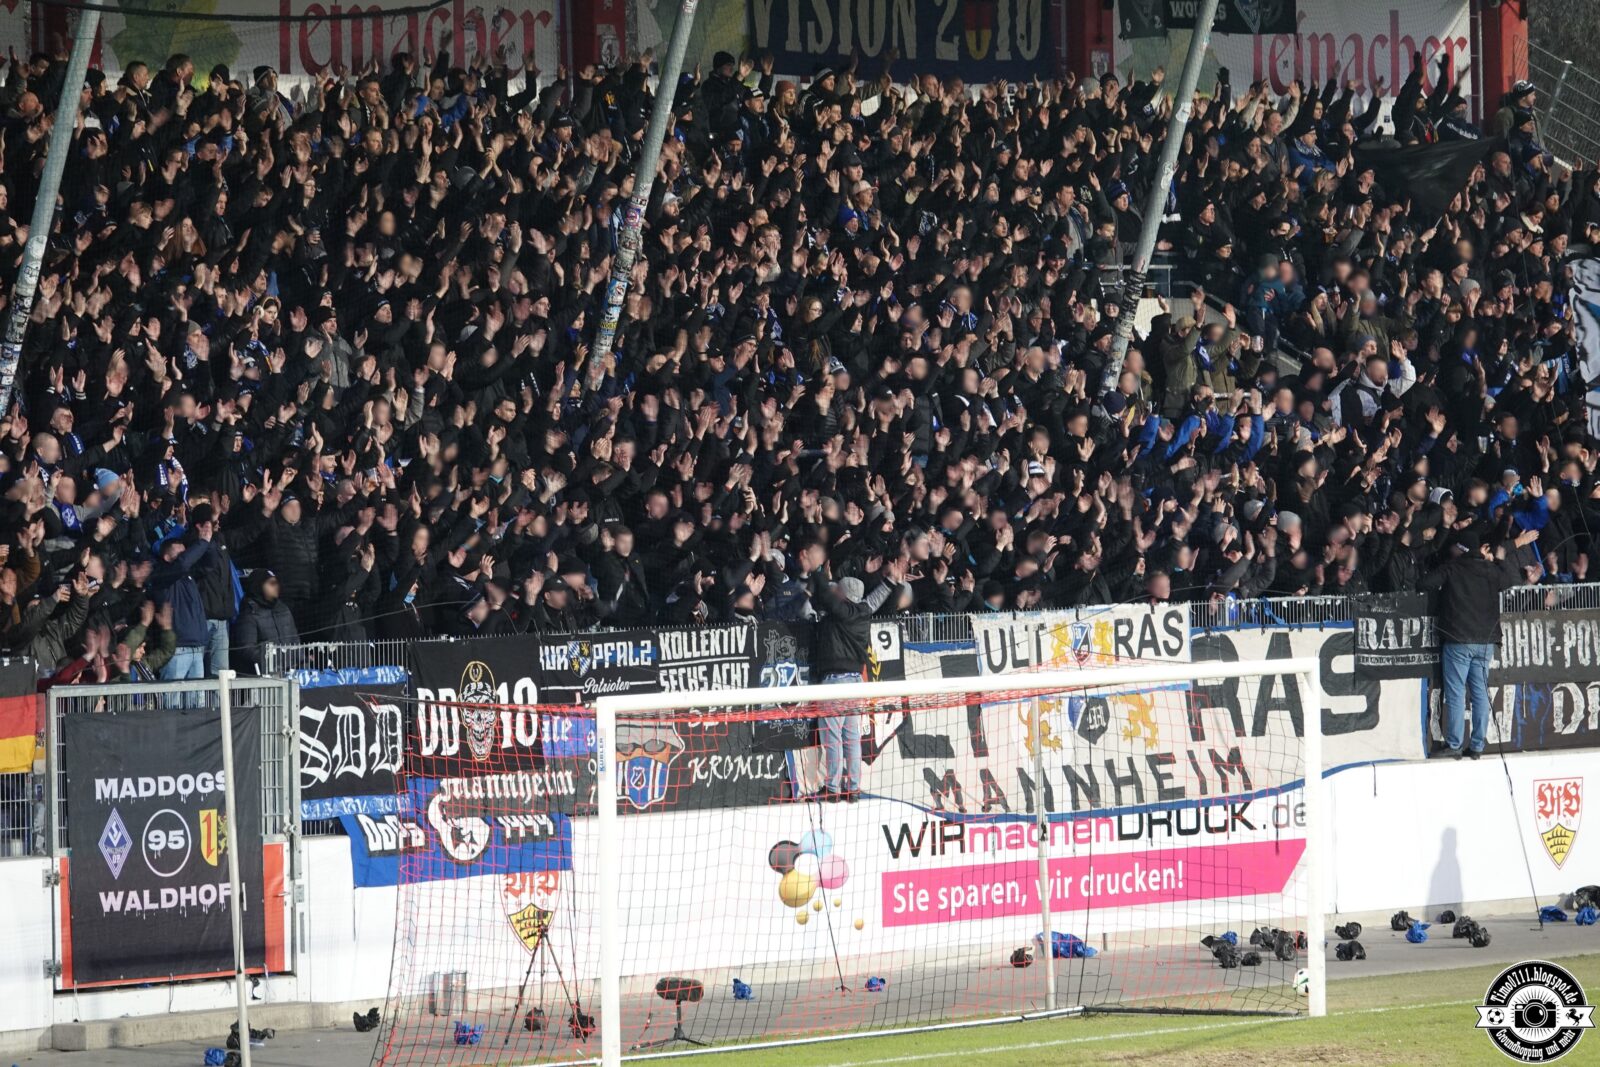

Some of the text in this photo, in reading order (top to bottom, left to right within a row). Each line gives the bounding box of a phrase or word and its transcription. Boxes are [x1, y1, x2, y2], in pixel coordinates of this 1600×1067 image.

[754, 0, 1042, 61] VISION 2010
[659, 625, 748, 661] KOLLEKTIV
[877, 630, 892, 650] 9
[1114, 609, 1184, 661] RAS
[660, 662, 750, 694] SECHS ACHT
[417, 687, 459, 756] DD
[95, 770, 226, 802] MADDOGS
[923, 746, 1253, 814] MANNHEIM
[148, 829, 185, 851] 95
[99, 882, 232, 914] WALDHOF
[893, 860, 1183, 917] Sie sparen, wir drucken!
